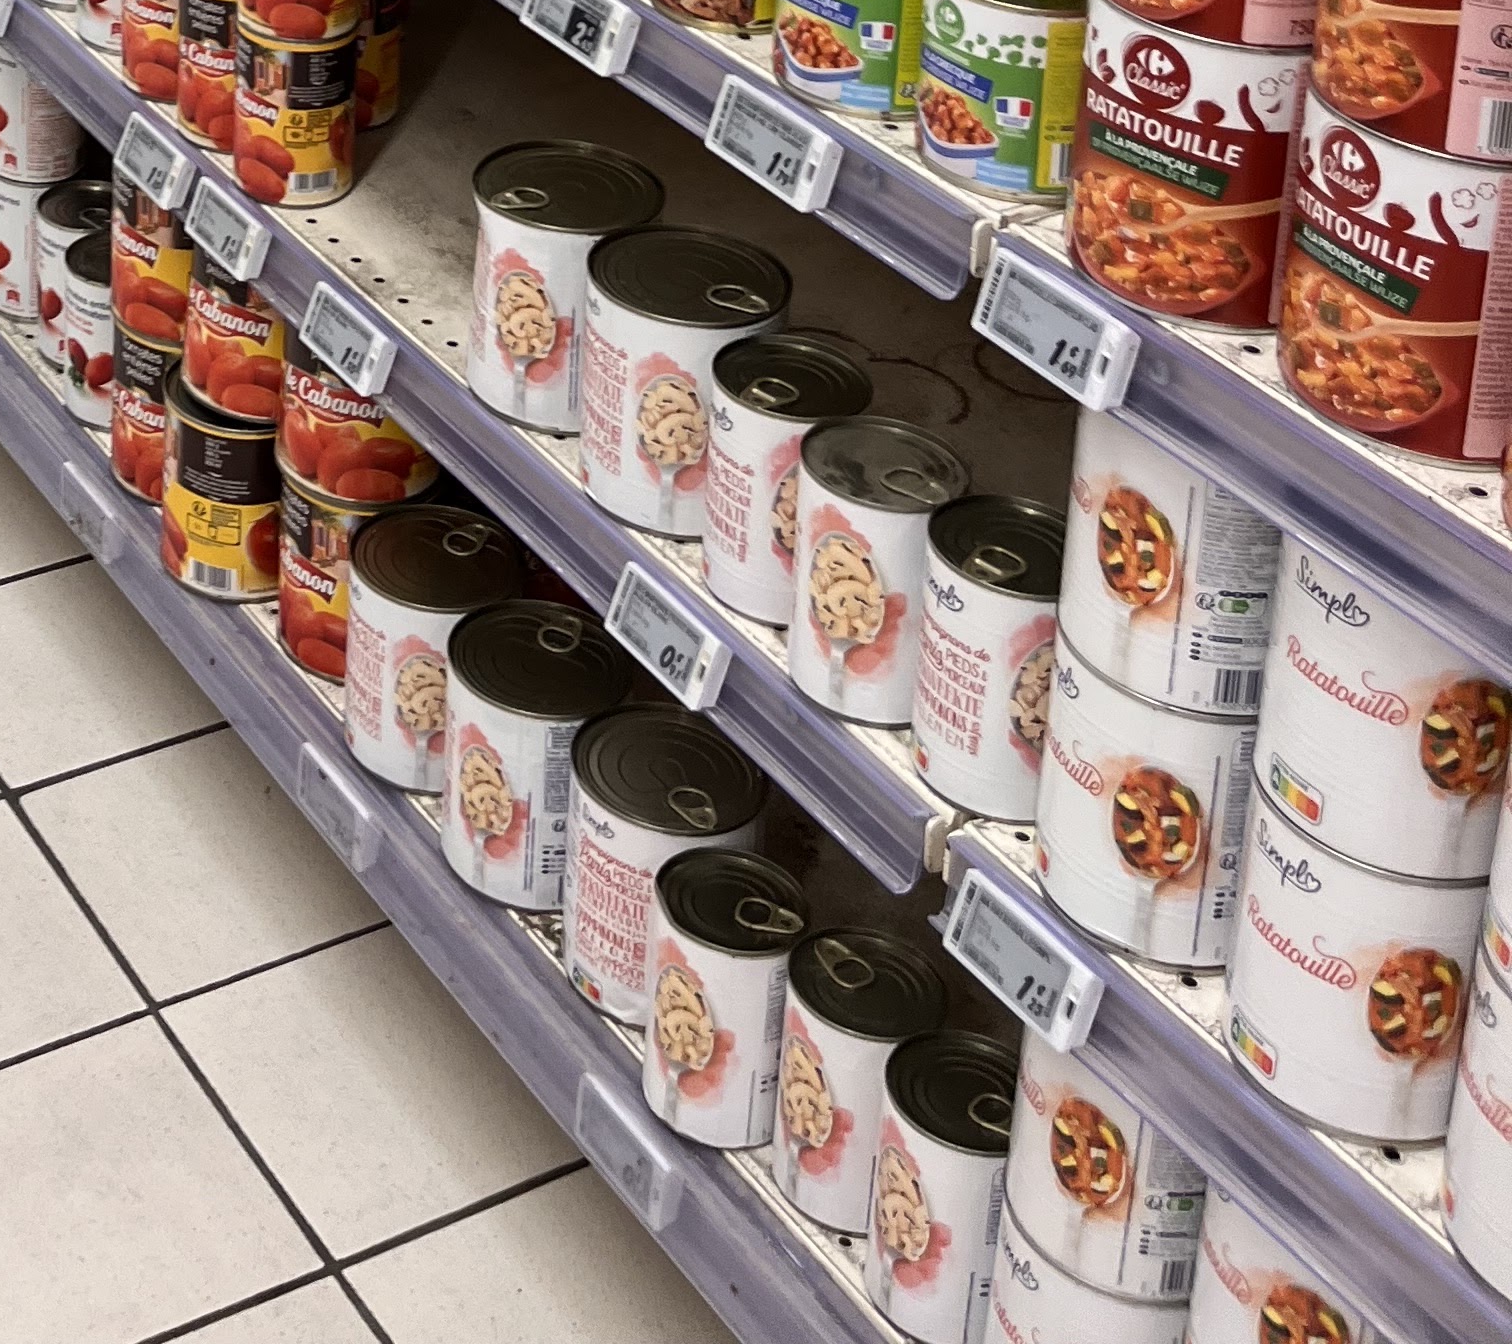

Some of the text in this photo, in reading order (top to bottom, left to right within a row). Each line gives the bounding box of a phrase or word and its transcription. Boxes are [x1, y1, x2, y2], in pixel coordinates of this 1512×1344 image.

[1085, 87, 1245, 168] RATATOUILLE
[1296, 186, 1435, 282] ATATOUILLE
[194, 290, 271, 338] Cabanon
[298, 375, 385, 421] Cabanon
[1286, 633, 1410, 727] Ratatouille
[1247, 894, 1358, 991] Ratatouille
